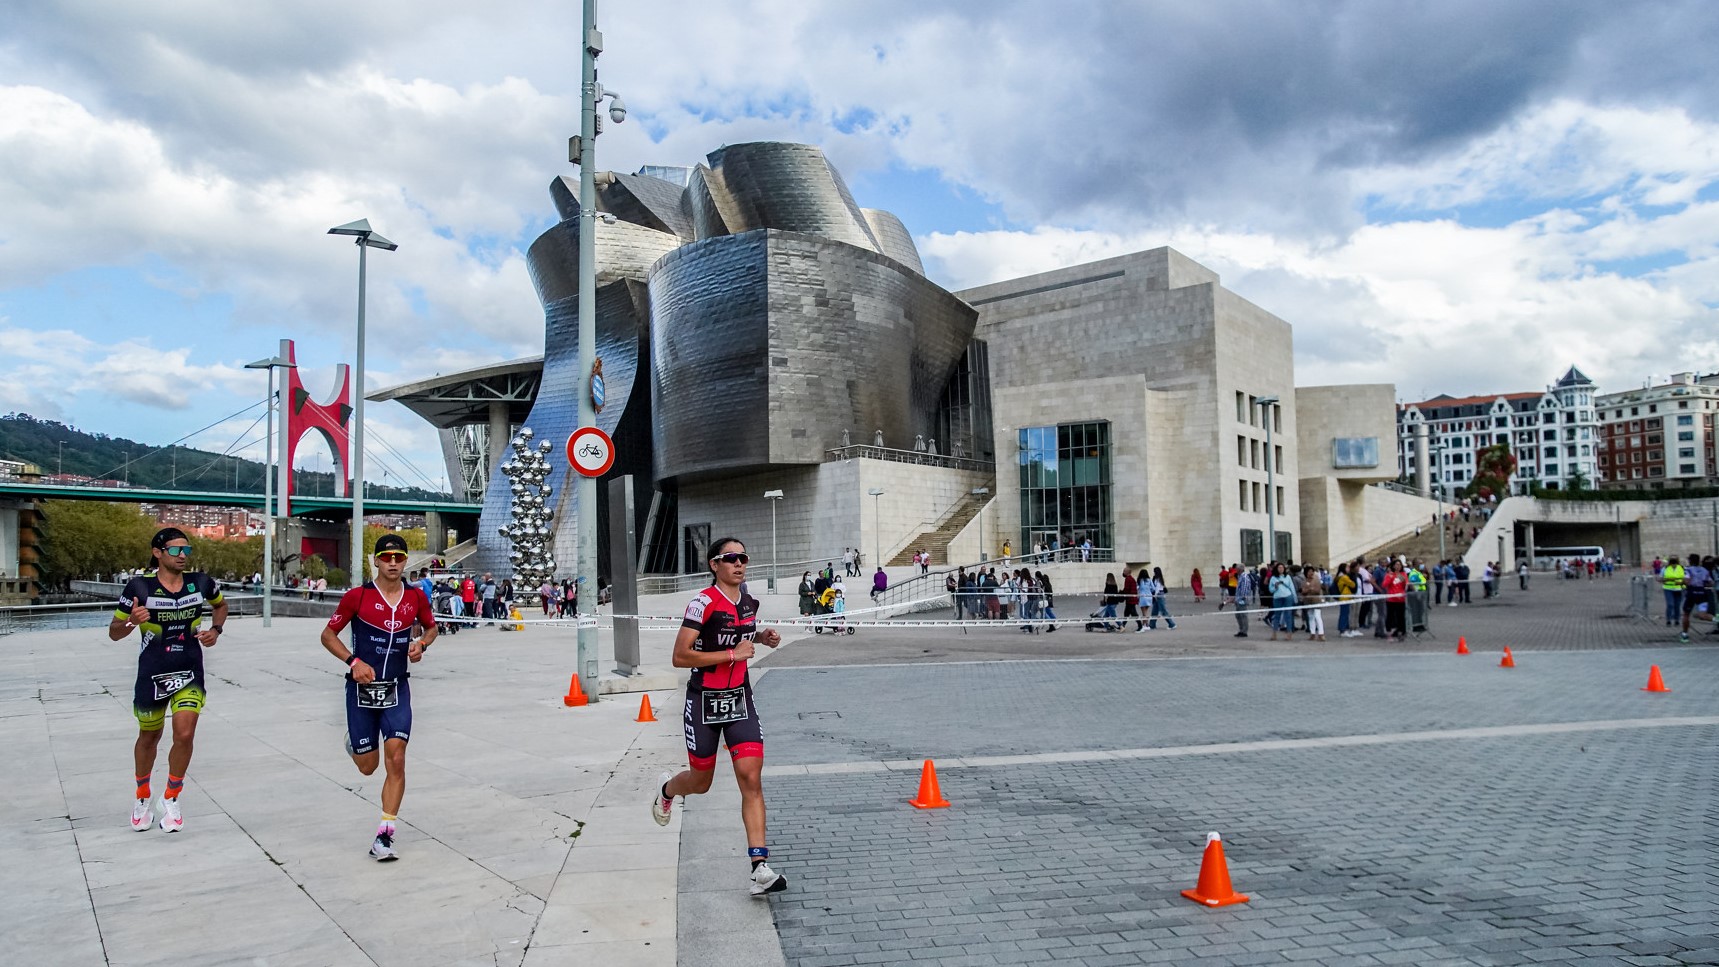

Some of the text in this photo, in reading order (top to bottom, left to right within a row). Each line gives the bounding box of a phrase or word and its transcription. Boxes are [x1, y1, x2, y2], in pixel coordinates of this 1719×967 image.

[717, 633, 737, 646] VIC
[164, 678, 183, 692] 28
[368, 690, 386, 701] 15
[710, 699, 736, 713] 151
[684, 698, 697, 751] VIC ETB
